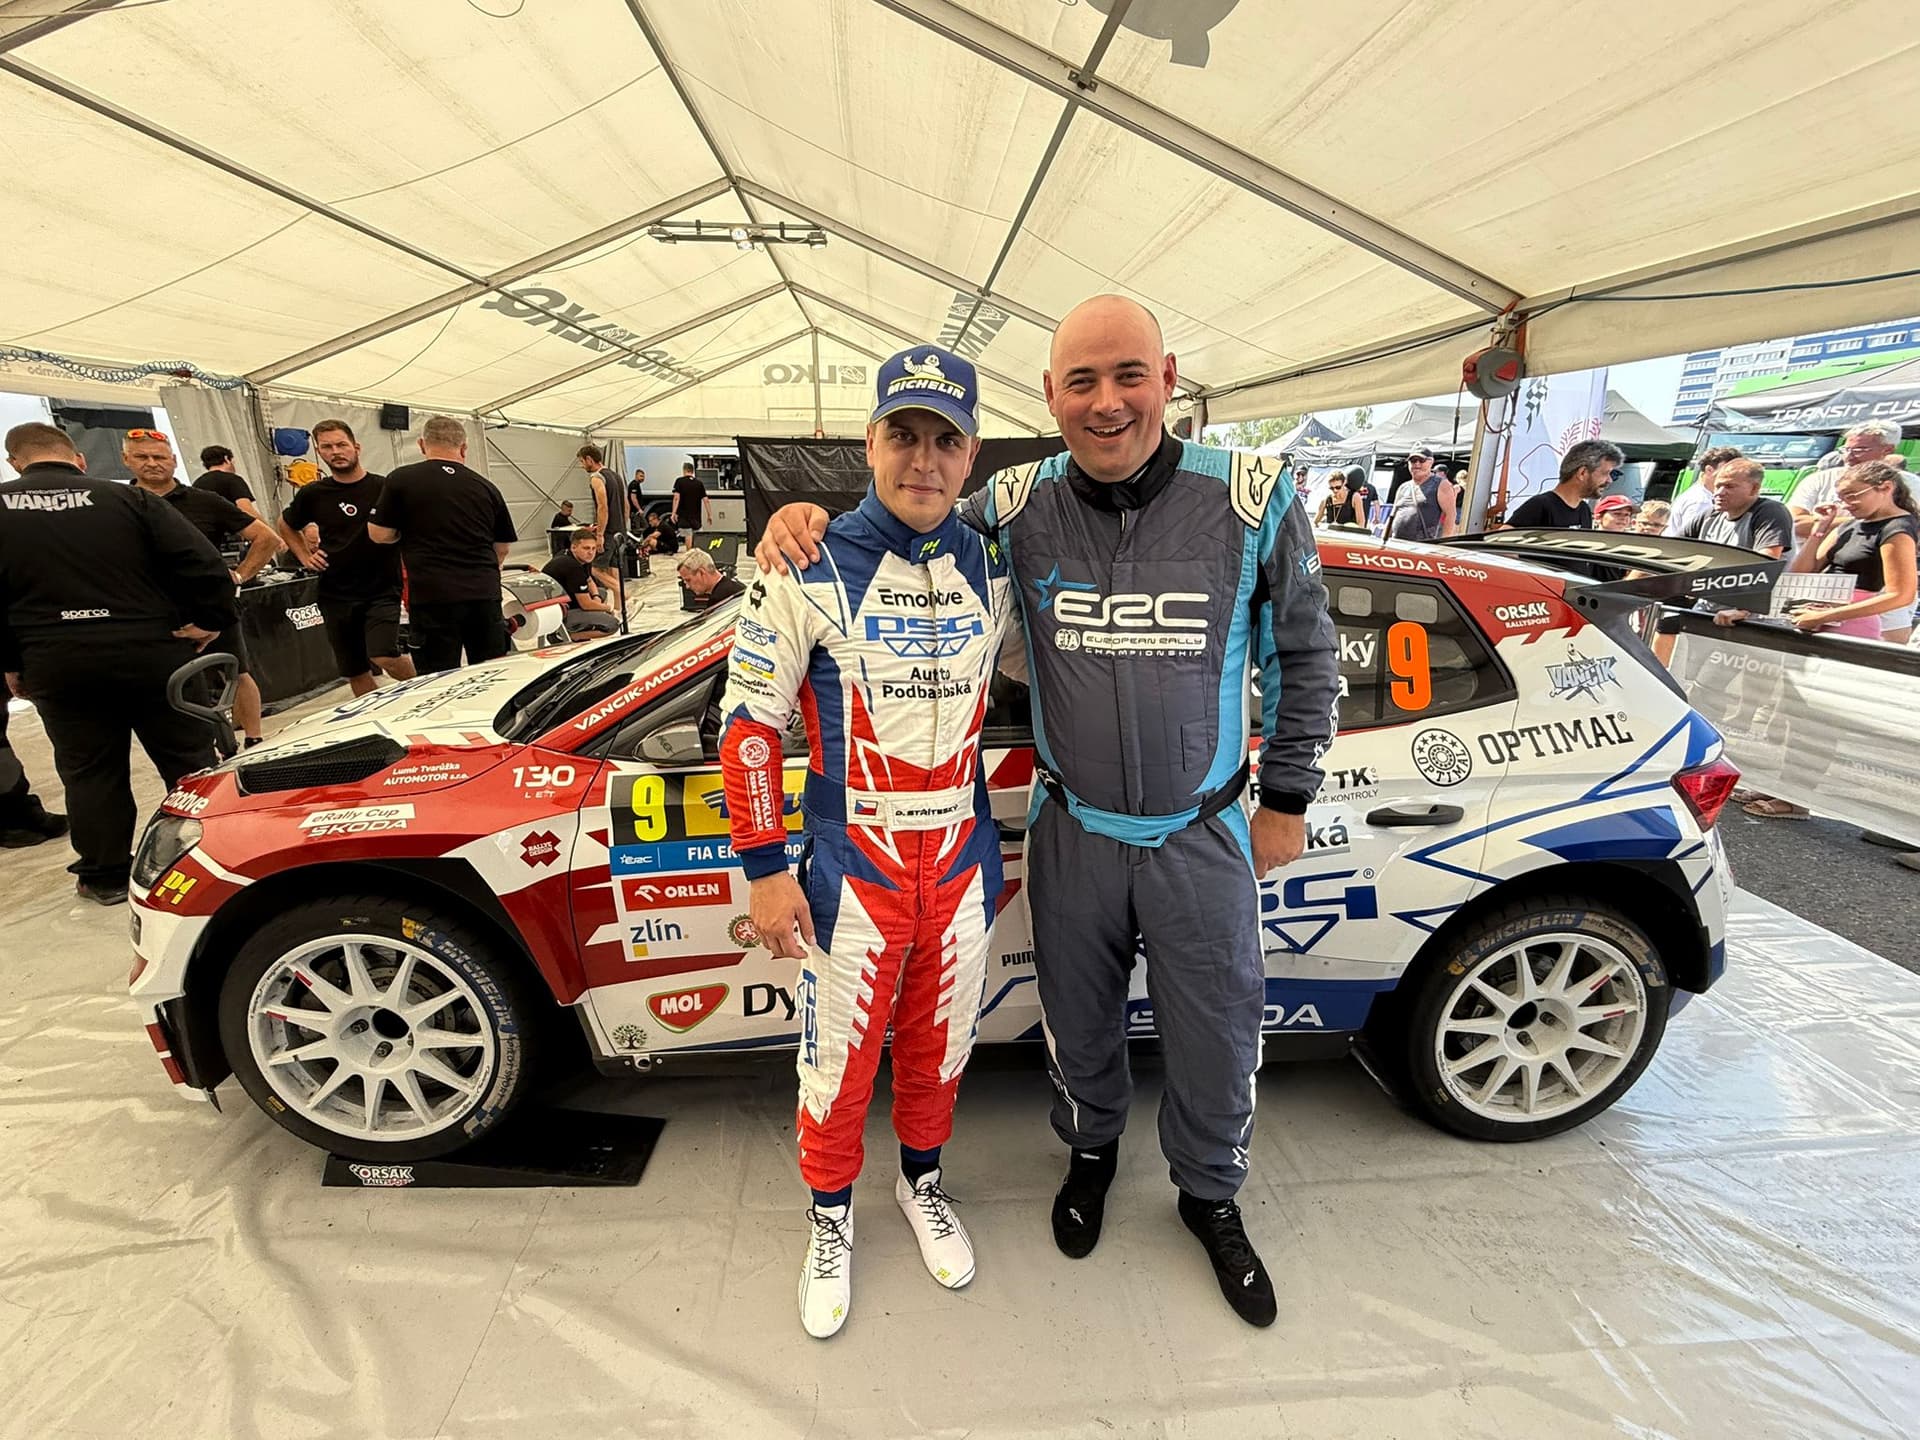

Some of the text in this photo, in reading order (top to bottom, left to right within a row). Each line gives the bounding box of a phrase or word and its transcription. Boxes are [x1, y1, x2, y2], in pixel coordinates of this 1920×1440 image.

[887, 379, 965, 400] MICHELIN
[1771, 400, 1920, 423] TRANSIT CUS
[1437, 563, 1489, 582] E-shop
[60, 608, 111, 620] sparco
[1054, 590, 1210, 628] ERC
[1504, 617, 1550, 629] RALLYSPORT
[1086, 635, 1156, 646] EUROPEAN
[1159, 637, 1203, 646] RALLY
[1085, 648, 1203, 657] CHAMPIONSHIP
[1387, 621, 1432, 711] 9
[574, 634, 735, 731] VANCIK-MOTORSP
[512, 764, 576, 788] 130
[1418, 748, 1469, 783] OPTIMAL
[384, 773, 448, 786] AUTOMOTOR
[1332, 767, 1373, 790] TK
[758, 770, 774, 830] AUTOKLU
[1331, 789, 1379, 803] KONTROLY
[312, 808, 400, 823] eRally Cup
[631, 774, 668, 842] 9
[624, 845, 741, 864] ERC FIA ER
[664, 883, 720, 898] ORLEN
[1001, 951, 1035, 967] PUM
[660, 993, 704, 1016] MOL
[743, 983, 797, 1022] Dy
